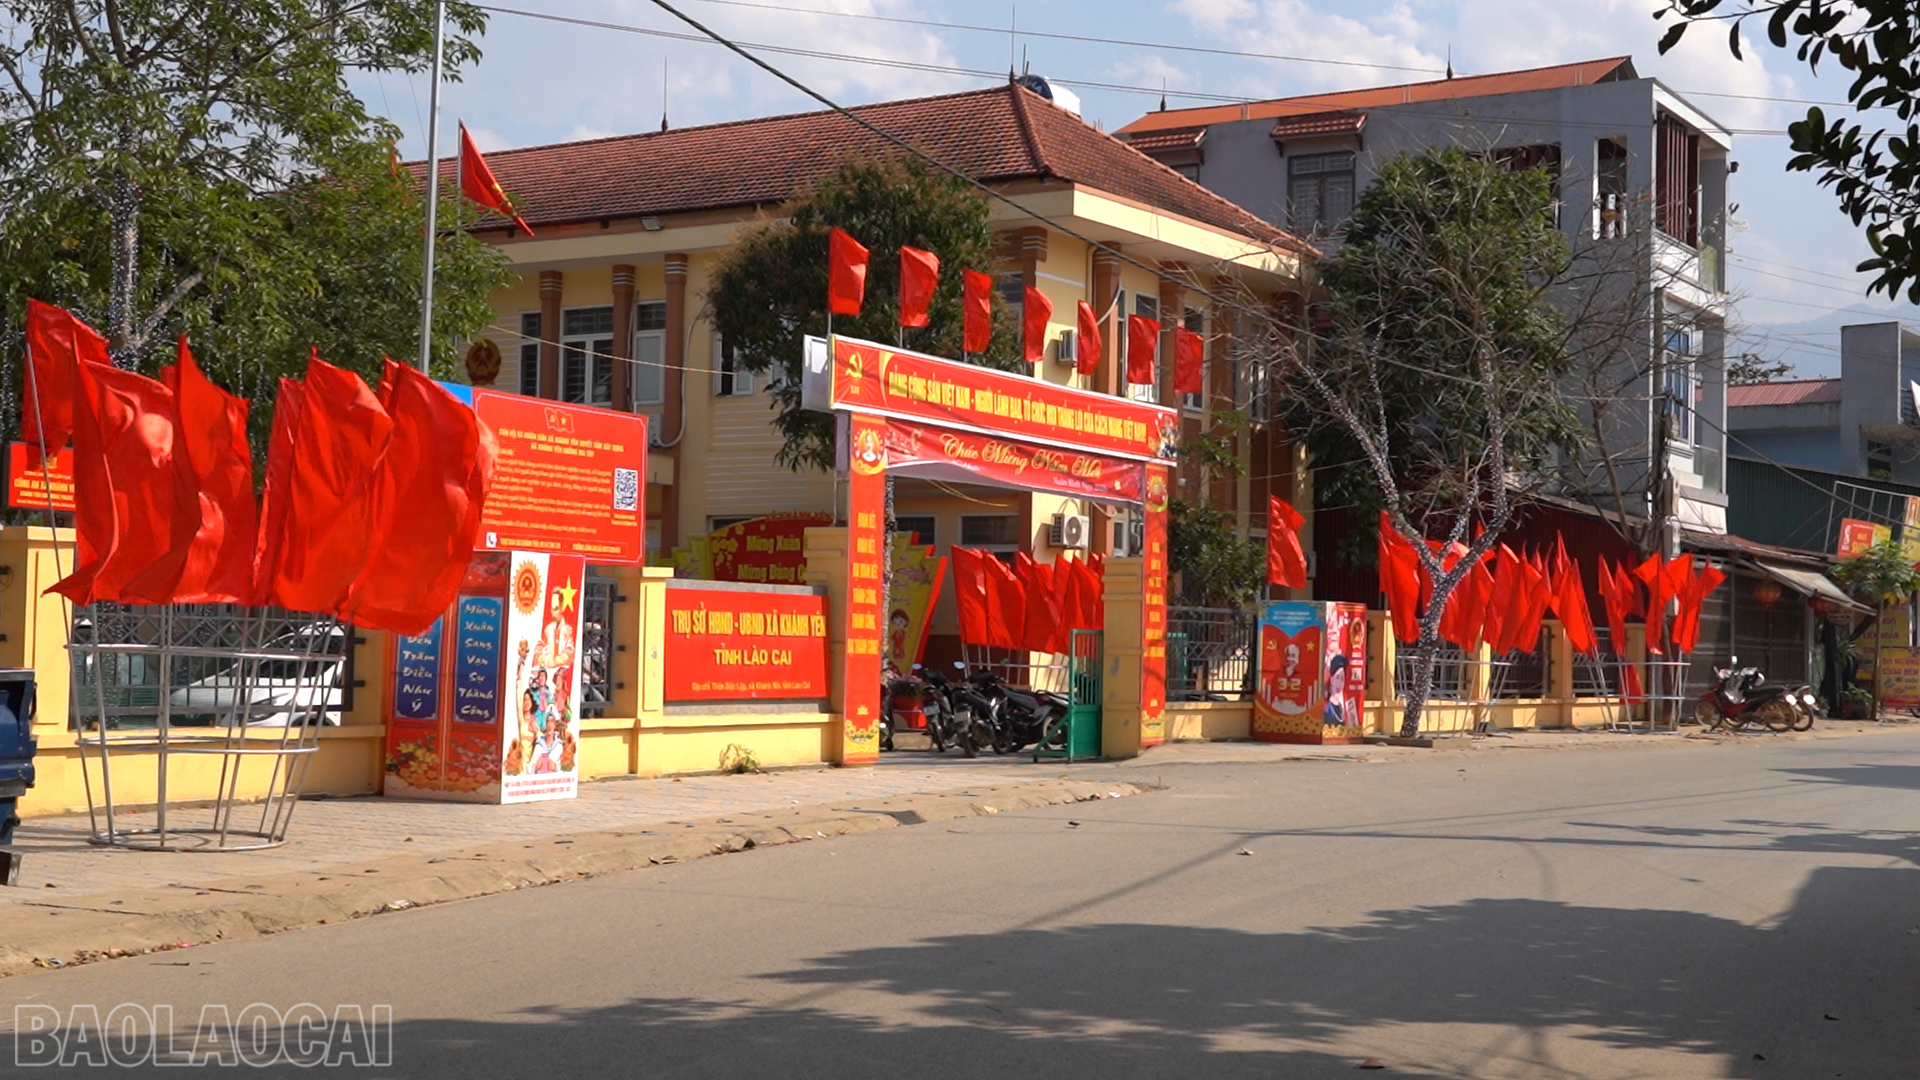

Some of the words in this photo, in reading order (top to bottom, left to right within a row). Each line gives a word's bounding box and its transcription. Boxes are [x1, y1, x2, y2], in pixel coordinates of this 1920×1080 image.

[909, 371, 926, 405] CỘNG
[928, 373, 940, 404] SẢN
[942, 379, 955, 411] VIỆT
[956, 385, 970, 410] NAM
[975, 386, 994, 414] NGƯỜI
[994, 390, 1010, 417] LÃNH
[940, 434, 979, 459] Chúc
[982, 440, 1028, 475] Mừng
[1031, 449, 1068, 473] Năm
[776, 534, 800, 551] Xuân
[738, 564, 767, 582] Mừng
[465, 621, 494, 632] Xuân
[672, 610, 691, 639] TRỤ
[693, 602, 707, 634] SỞ
[739, 612, 765, 636] UBND
[765, 610, 779, 636] XÃ
[779, 610, 809, 637] KHÁNH
[810, 611, 827, 637] YÊN
[465, 638, 493, 650] Sang
[402, 651, 435, 662] Trăm
[466, 655, 489, 666] Vạn
[714, 643, 742, 665] TỈNH
[744, 645, 768, 665] LÀO
[772, 650, 792, 665] CAI
[402, 666, 432, 679] Điều
[469, 672, 485, 684] Sự
[403, 684, 432, 696] Như
[459, 687, 494, 700] Thành
[412, 699, 422, 712] Ý
[461, 704, 490, 719] Công
